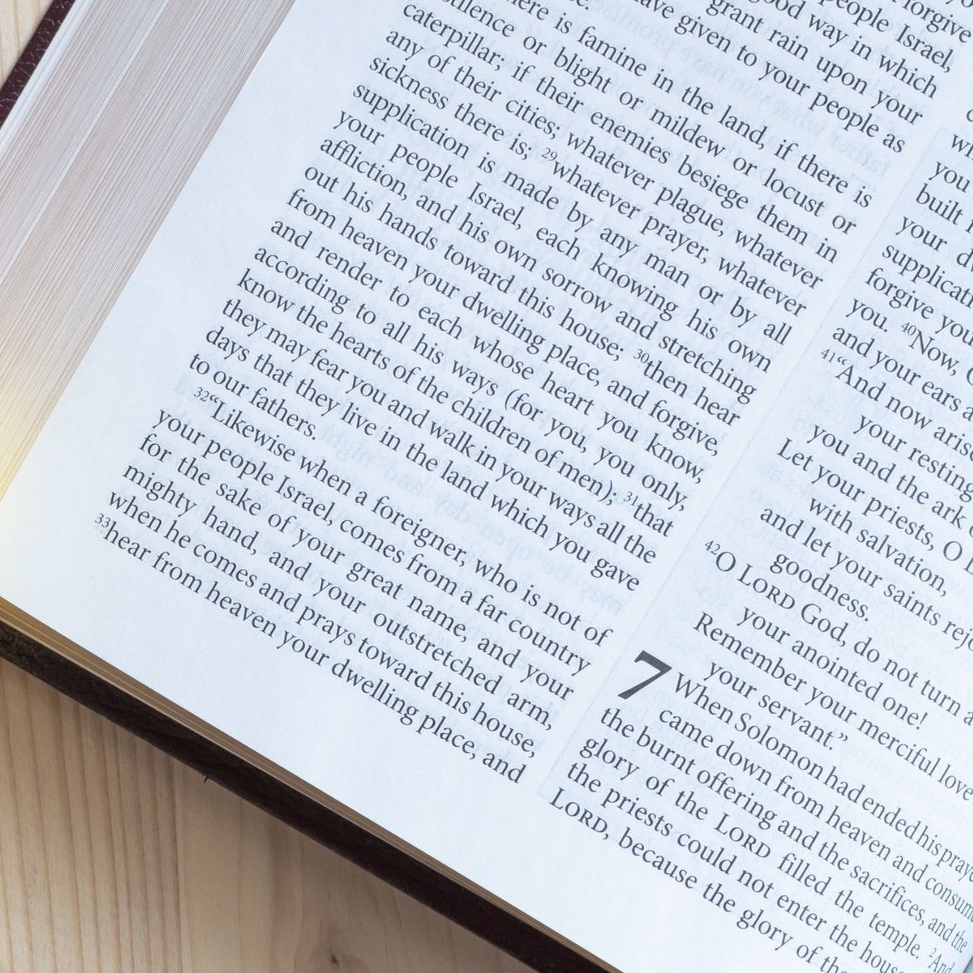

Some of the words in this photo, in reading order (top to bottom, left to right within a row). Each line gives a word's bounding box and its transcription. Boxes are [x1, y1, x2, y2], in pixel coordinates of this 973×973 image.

[402, 4, 505, 71] caterpillar;
[511, 61, 536, 83] if
[535, 76, 584, 113] their
[589, 111, 671, 164] enemies
[676, 154, 749, 209] besiege
[756, 204, 808, 246] them
[814, 237, 837, 264] in
[705, 0, 764, 34] grant
[767, 29, 808, 61] rain
[815, 56, 867, 95] upon
[870, 89, 923, 125] your
[352, 84, 469, 160] supplication
[476, 151, 496, 174] is
[502, 171, 559, 210] made
[566, 200, 594, 233] by
[599, 227, 639, 259] any
[642, 252, 690, 288] man
[698, 285, 723, 305] or
[729, 295, 758, 328] by
[762, 322, 792, 346] all
[385, 30, 424, 61] any
[427, 54, 456, 74] of
[453, 65, 502, 103] their
[505, 99, 560, 140] cities;
[567, 132, 655, 191] whatever
[652, 186, 724, 237] plague,
[734, 229, 823, 289] whatever
[894, 215, 947, 252] your
[915, 182, 963, 225] built
[286, 188, 336, 230] from
[338, 216, 408, 271] heaven
[407, 263, 460, 299] your
[461, 291, 546, 355] dwelling
[542, 343, 600, 387] place,
[606, 379, 650, 410] and
[648, 399, 718, 457] forgive,
[319, 139, 407, 201] affliction,
[415, 194, 458, 224] and
[458, 212, 489, 243] his
[493, 239, 537, 272] own
[541, 267, 613, 314] sorrow
[614, 310, 658, 340] and
[657, 335, 757, 405] stretching
[864, 267, 934, 320] forgive
[189, 353, 210, 375] to
[212, 370, 249, 397] our
[248, 386, 316, 440] fathers.
[205, 325, 250, 362] days
[253, 353, 293, 387] that
[295, 378, 341, 417] they
[339, 401, 377, 436] live
[378, 426, 401, 452] in
[405, 442, 438, 472] the
[439, 459, 489, 500] land
[490, 493, 548, 539] which
[548, 531, 591, 563] you
[589, 558, 640, 591] gave
[222, 298, 267, 337] they
[264, 327, 311, 363] may
[308, 348, 349, 382] fear
[344, 374, 387, 406] you
[387, 399, 430, 429] and
[429, 420, 475, 458] walk
[474, 445, 497, 471] in
[494, 462, 547, 498] your
[548, 491, 596, 528] ways
[595, 520, 626, 545] all
[623, 534, 656, 564] the
[253, 247, 351, 315] according
[355, 303, 376, 325] to
[381, 320, 411, 344] all
[411, 333, 444, 364] his
[451, 359, 498, 396] ways
[504, 388, 543, 422] (for
[543, 417, 586, 453] you,
[592, 446, 635, 478] you
[641, 474, 688, 512] only,
[852, 415, 907, 452] your
[906, 447, 973, 503] resting
[151, 409, 206, 445] your
[200, 439, 274, 486] people
[275, 474, 335, 526] Israel,
[339, 519, 405, 564] comes
[405, 553, 457, 596] from
[459, 590, 473, 606] a
[474, 594, 508, 623] far
[508, 619, 591, 677] country
[806, 424, 850, 457] you
[851, 452, 896, 483] and
[895, 474, 929, 505] the
[931, 500, 966, 530] ark
[809, 497, 853, 535] with
[855, 529, 946, 597] salvation,
[109, 491, 162, 533] when
[163, 519, 191, 549] he
[192, 544, 258, 588] comes
[258, 582, 302, 613] and
[295, 605, 356, 646] prays
[357, 637, 433, 691] toward
[431, 681, 471, 715] this
[470, 701, 535, 758] house,
[122, 465, 197, 518] mighty
[201, 505, 259, 556] hand,
[268, 551, 312, 581] and
[312, 577, 366, 614] your
[372, 612, 503, 695] outstretched
[506, 692, 552, 731] arm,
[702, 661, 757, 699] your
[736, 607, 790, 644] your
[791, 640, 883, 702] anointed
[882, 696, 928, 730] one!
[769, 553, 868, 622] goodness.
[617, 649, 672, 700] 7
[674, 672, 733, 725] When
[733, 712, 823, 780] Solomon
[822, 765, 866, 804] had
[861, 797, 921, 840] ended
[915, 825, 942, 856] his
[692, 611, 807, 692] Remember
[804, 686, 857, 723] your
[856, 718, 941, 777] merciful
[937, 764, 973, 801] love
[567, 762, 601, 793] the
[600, 787, 673, 837] priests
[676, 833, 737, 875] could
[736, 869, 774, 899] not
[776, 894, 827, 931] enter
[828, 924, 858, 952] the
[600, 707, 634, 738] the
[635, 725, 695, 775] burnt
[696, 769, 777, 830] offering
[777, 819, 820, 851] and
[817, 841, 849, 871] the
[849, 865, 925, 926] sacrifices,
[927, 917, 957, 942] and
[950, 929, 968, 954] the
[617, 826, 697, 889] because
[702, 882, 736, 913] the
[735, 909, 793, 951] glory
[795, 944, 823, 964] of
